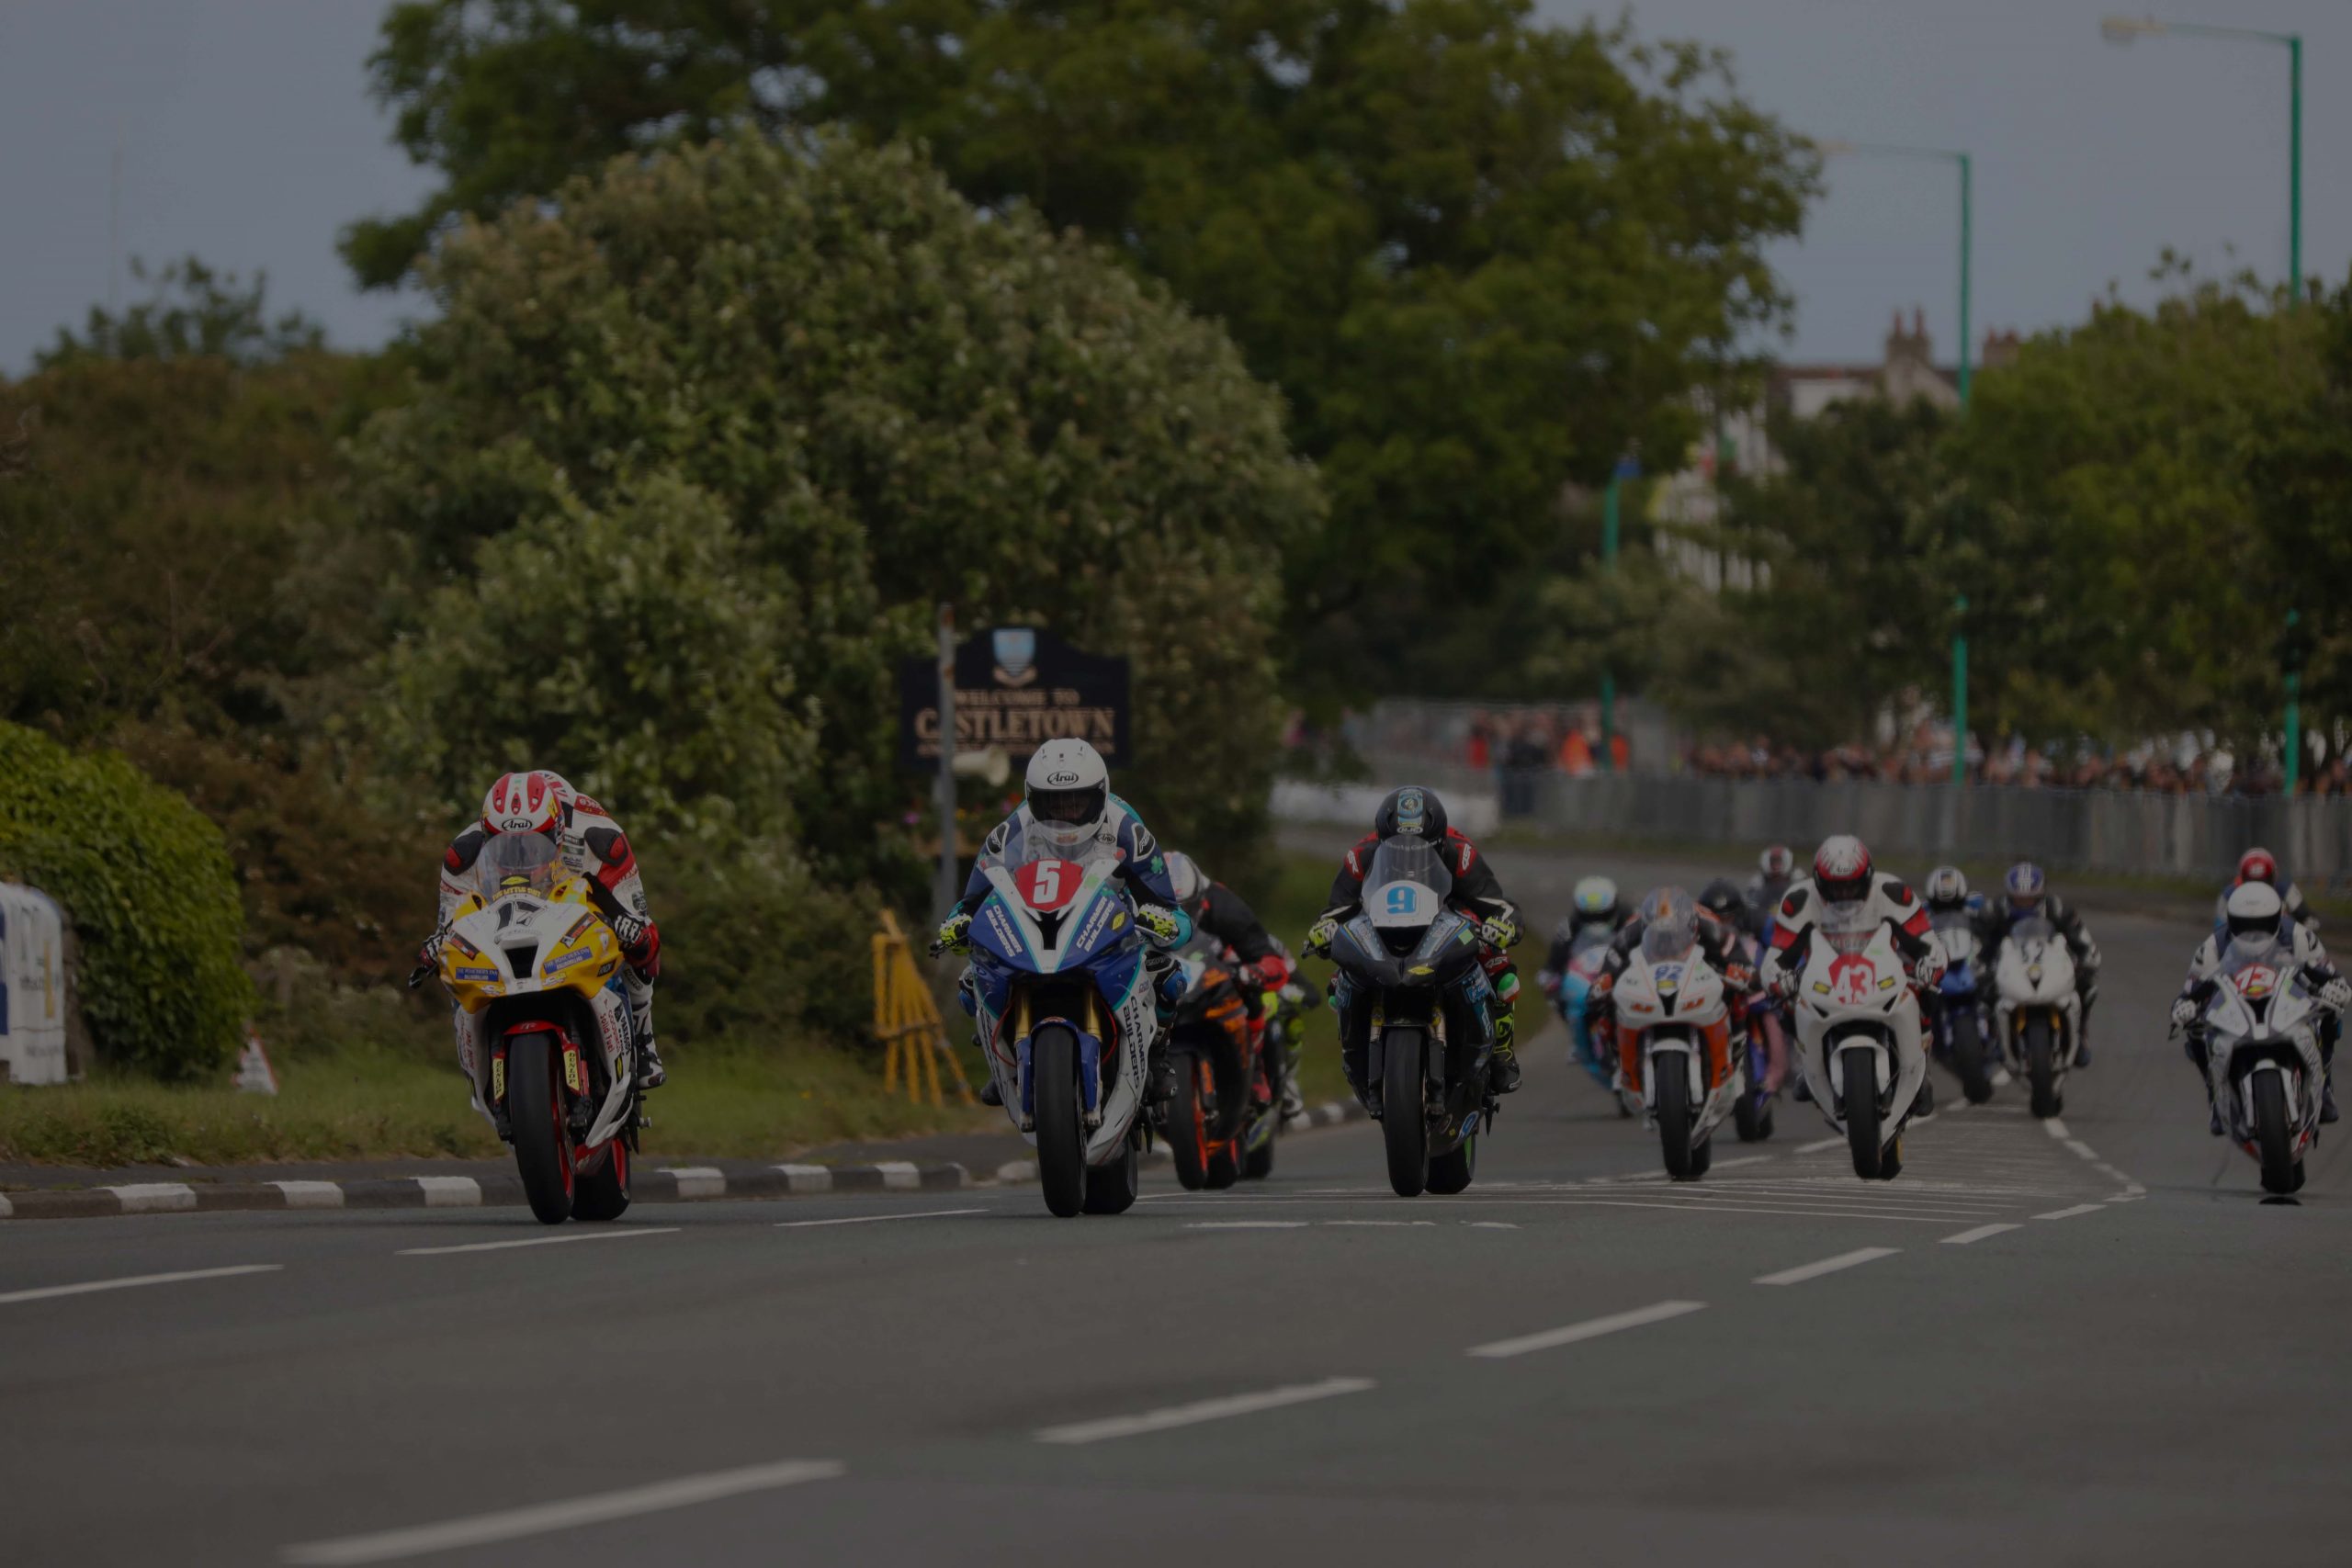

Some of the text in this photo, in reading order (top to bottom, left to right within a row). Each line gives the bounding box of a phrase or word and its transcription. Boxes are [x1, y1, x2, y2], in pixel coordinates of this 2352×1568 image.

[914, 706, 1116, 739] CSTLETOWN
[1049, 772, 1074, 781] Arai
[503, 818, 528, 829] Arai
[1033, 860, 1061, 904] 5
[1386, 886, 1418, 914] 9
[986, 909, 1015, 957] BUILDERS
[993, 905, 1023, 953] CHARMER
[1076, 896, 1108, 948] CHARMER
[1084, 900, 1115, 952] BUILDERS
[1837, 964, 1874, 1005] 43
